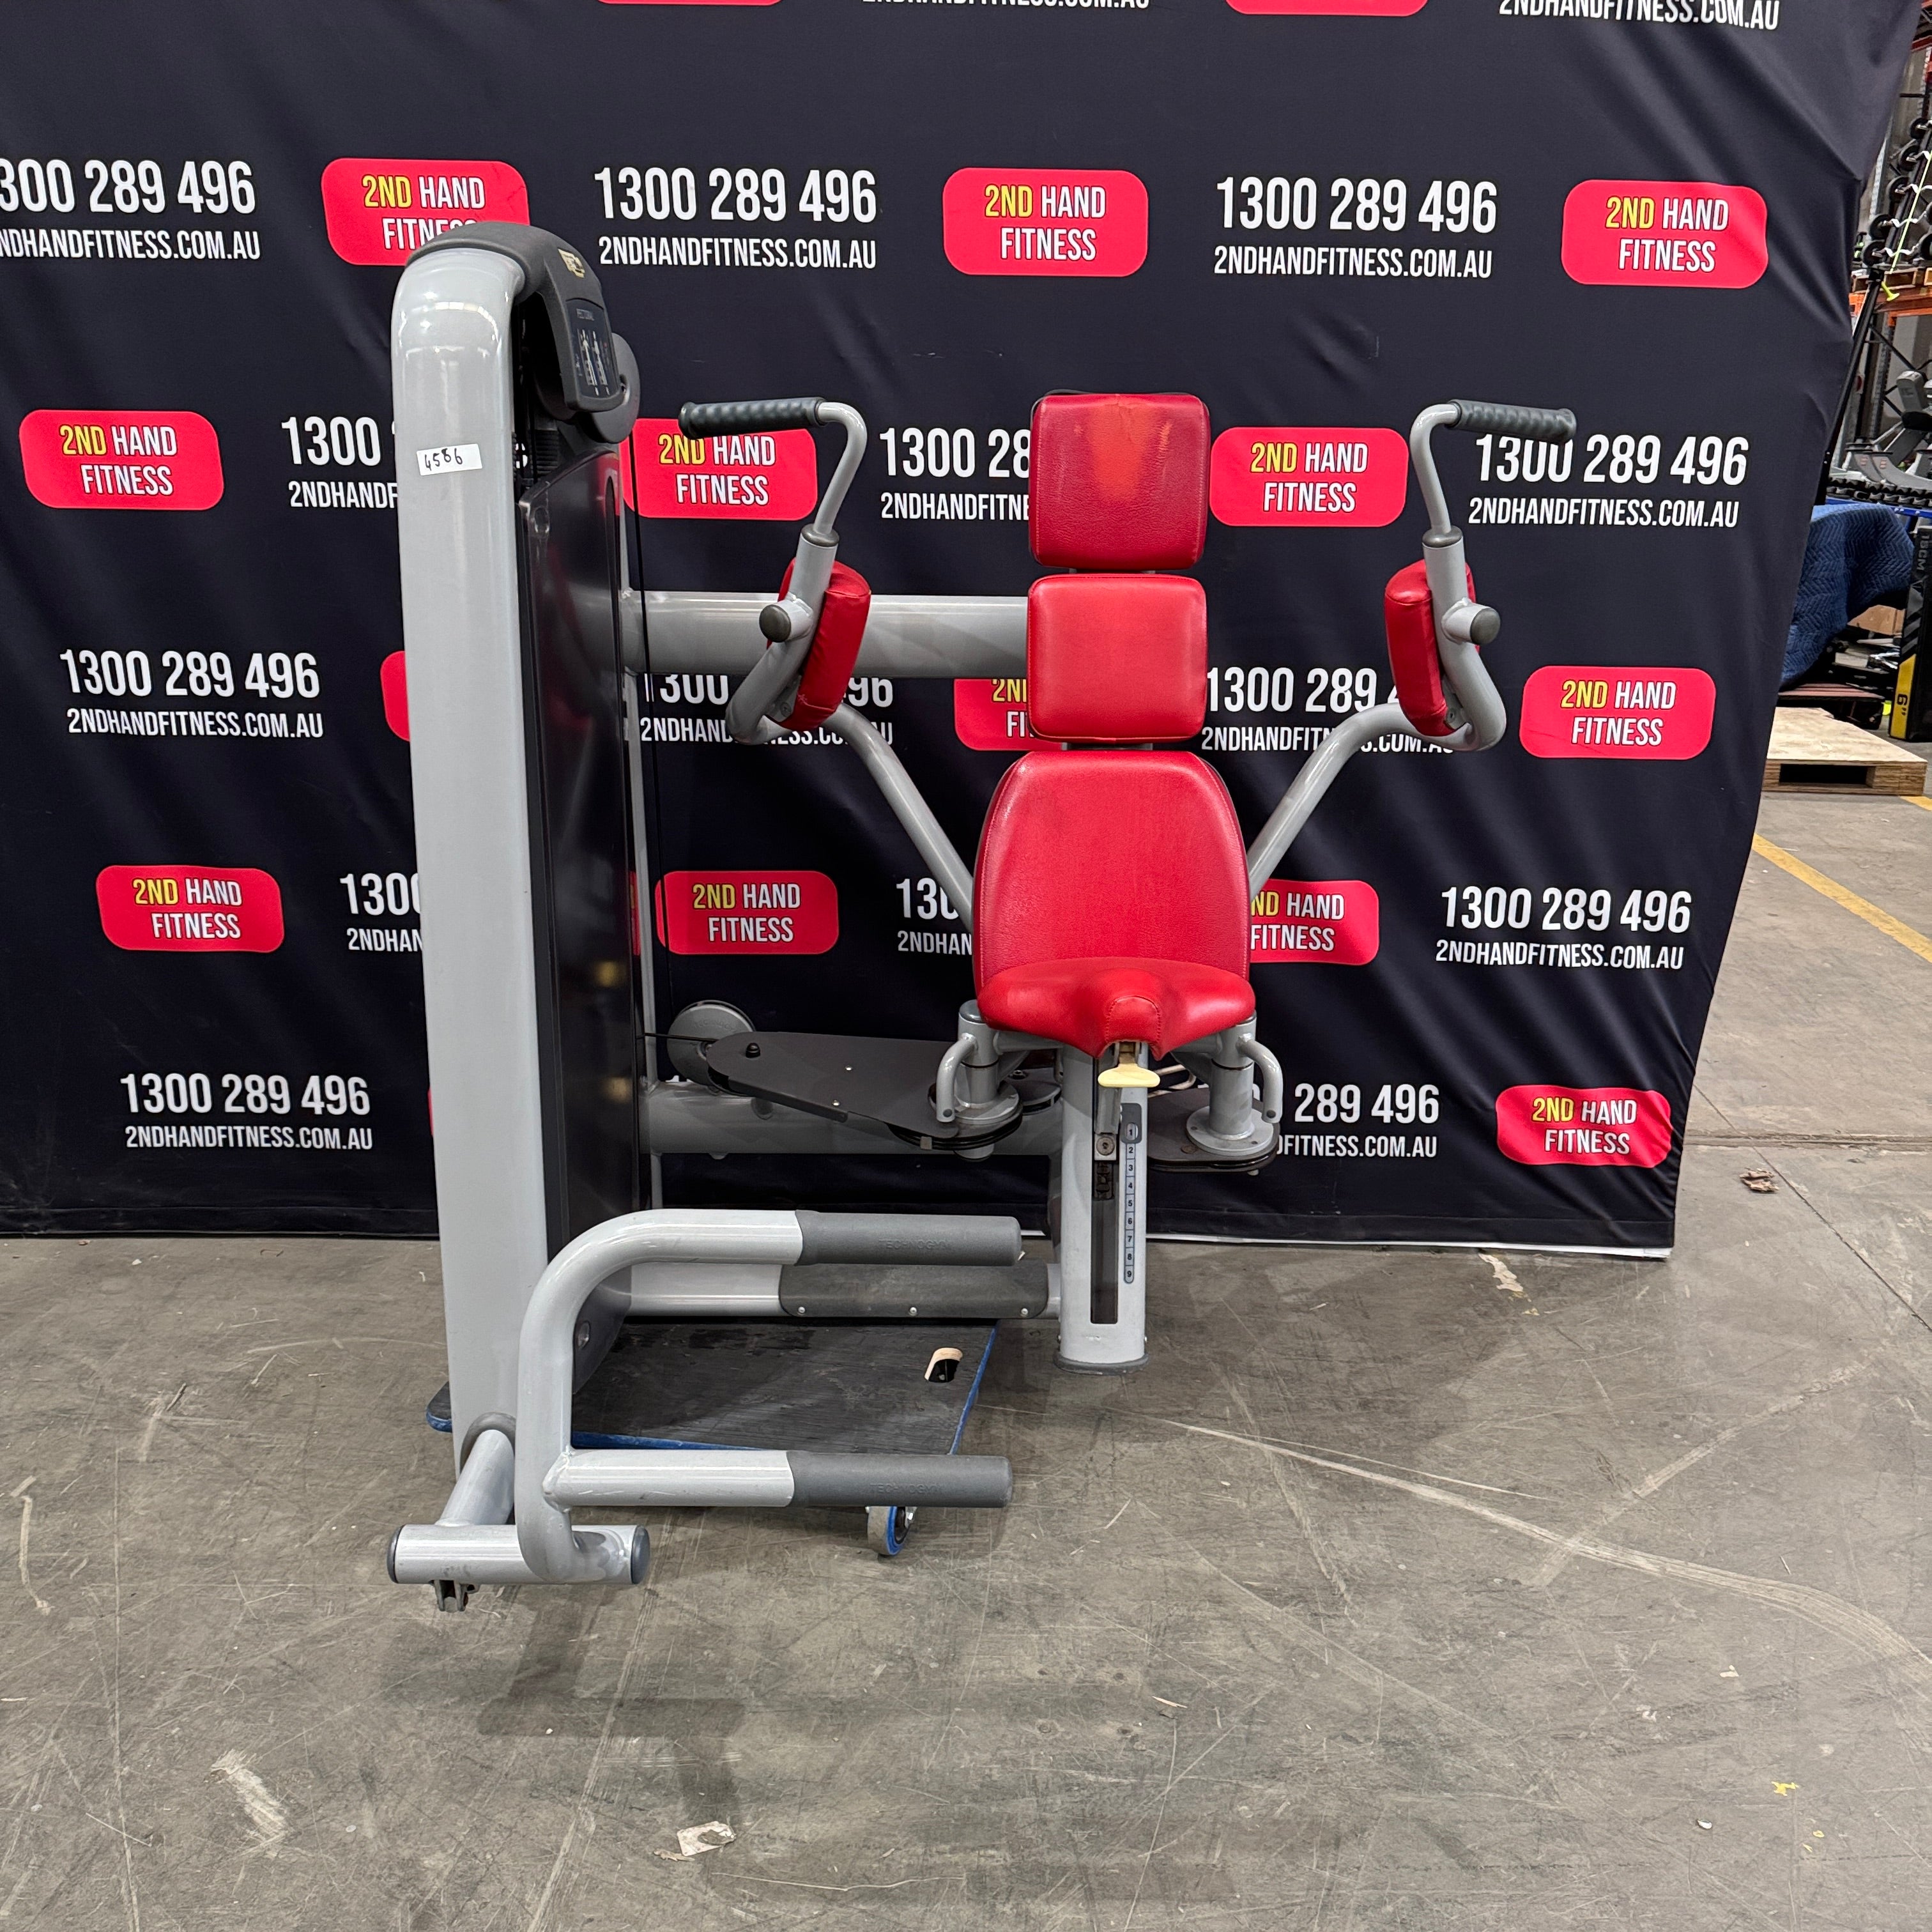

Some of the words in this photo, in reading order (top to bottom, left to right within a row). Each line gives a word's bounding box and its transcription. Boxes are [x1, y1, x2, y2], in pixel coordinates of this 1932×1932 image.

[0, 158, 75, 213] 300
[84, 160, 165, 213] 289
[177, 160, 256, 214] 496
[363, 176, 411, 207] 2ND
[419, 176, 485, 208] HAND
[594, 167, 697, 220] 1300
[709, 167, 786, 222] 289
[799, 169, 877, 223] 496
[986, 185, 1032, 217] 2ND
[1041, 186, 1105, 218] HAND
[1216, 176, 1317, 230] 1300
[1330, 178, 1407, 232] 289
[1418, 180, 1497, 233] 496
[1606, 197, 1654, 229] 2ND
[1662, 198, 1728, 230] HAND
[0, 228, 261, 260] NDHANDFITNESS.COM.AU
[381, 217, 478, 250] FITN
[1001, 227, 1096, 261] FITNESS
[599, 236, 876, 269] 2NDHANDFITNESS.COM.AU
[1214, 245, 1492, 279] 2NDHANDFITNESS.COM.AU
[1619, 239, 1715, 272] FITNESS
[60, 425, 106, 455] 2ND
[111, 426, 177, 456] HAND
[281, 416, 381, 466] 1300
[659, 434, 705, 464] 2ND
[712, 435, 775, 465] HAND
[879, 427, 976, 478] 1300
[988, 429, 1031, 479] 28
[1251, 443, 1297, 472] 2ND
[1305, 443, 1368, 472] HAND
[1476, 434, 1574, 482] 1300
[1583, 434, 1661, 484] 289
[1669, 436, 1749, 486] 496
[81, 464, 173, 495] FITNESS
[677, 474, 769, 505] FITNESS
[1264, 482, 1356, 512] FITNESS
[1468, 497, 1739, 528] 2NDHANDFITNESS.COM.AU
[59, 648, 152, 696] 1300
[162, 650, 234, 697] 289
[245, 652, 319, 698] 496
[843, 677, 893, 708] 96
[992, 678, 1027, 703] 2N
[1207, 666, 1294, 712] 1300
[1305, 668, 1377, 712] 289
[1561, 680, 1607, 708] 2ND
[1614, 681, 1676, 709] HAND
[66, 708, 323, 738] 2NDHANDFITNESS.COM.AU
[1572, 717, 1663, 746] FITNESS
[133, 879, 178, 904] 2ND
[186, 878, 241, 905] HAND
[693, 884, 735, 908] 2ND
[743, 884, 801, 908] HAND
[1250, 891, 1280, 917] ND
[1287, 893, 1344, 920] HAND
[1441, 885, 1532, 929] 1300
[1542, 887, 1611, 931] 289
[1620, 889, 1692, 933] 496
[152, 913, 240, 939] FITNESS
[709, 917, 793, 942] FITNESS
[1250, 924, 1334, 951] FITNESS
[1436, 939, 1684, 970] 2NDHANDFITNESS.COM.AU
[120, 1073, 211, 1113] 1300
[222, 1073, 291, 1114] 289
[301, 1075, 370, 1115] 496
[1294, 1083, 1361, 1123] 289
[1371, 1084, 1439, 1124] 496
[1533, 1098, 1574, 1121] 2ND
[1582, 1100, 1637, 1125] HAND
[125, 1126, 372, 1150] 2NDHANDFITNESS.COM.AU
[1128, 1128, 1133, 1137] 1
[1545, 1129, 1630, 1154] FITNESS
